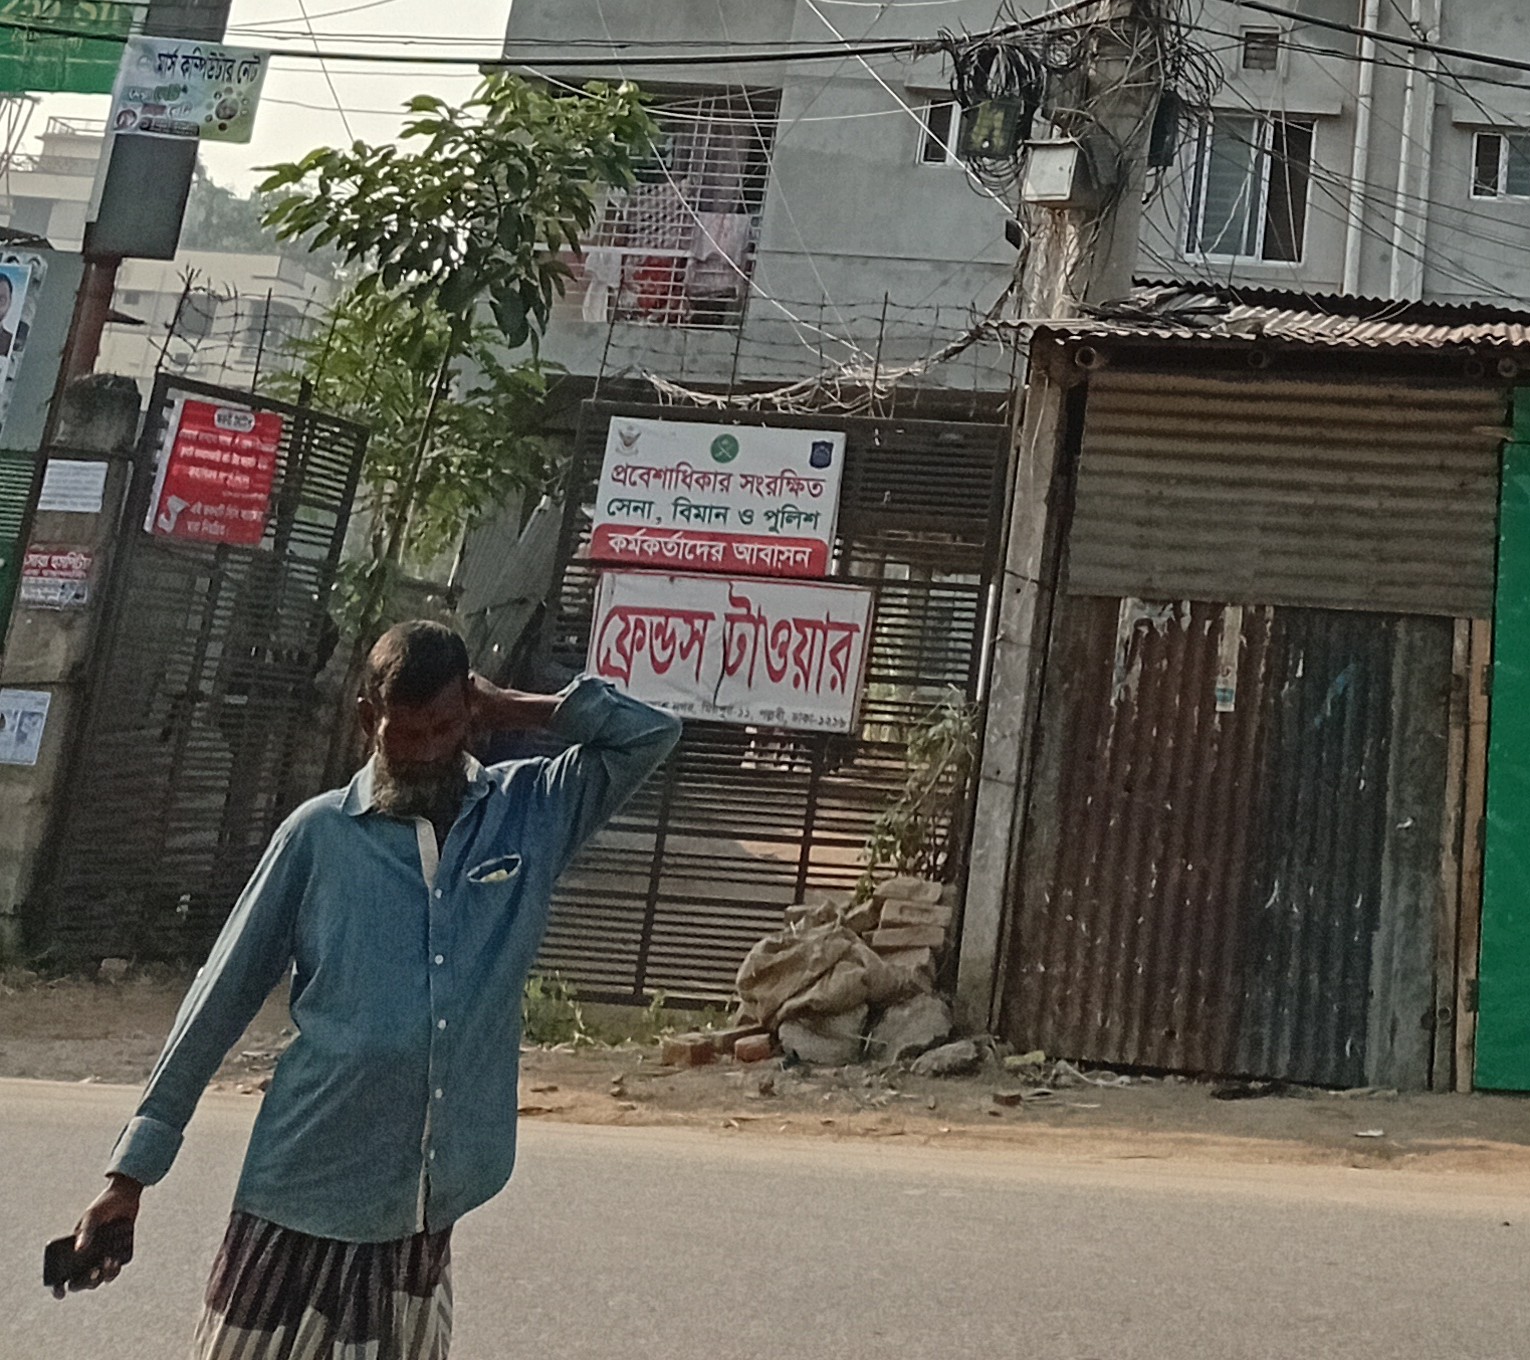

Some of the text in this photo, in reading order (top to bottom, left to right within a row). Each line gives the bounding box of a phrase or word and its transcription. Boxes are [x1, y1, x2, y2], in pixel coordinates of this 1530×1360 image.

[610, 460, 826, 499] প্রবেশাধিকার সংরক্ষিত
[606, 495, 821, 534] সেনা, বিমান ও পুলিশ
[607, 527, 813, 570] কর্মকর্তাদের আবাসন
[596, 582, 861, 696] ফ্রেন্ডস টাওয়ার
